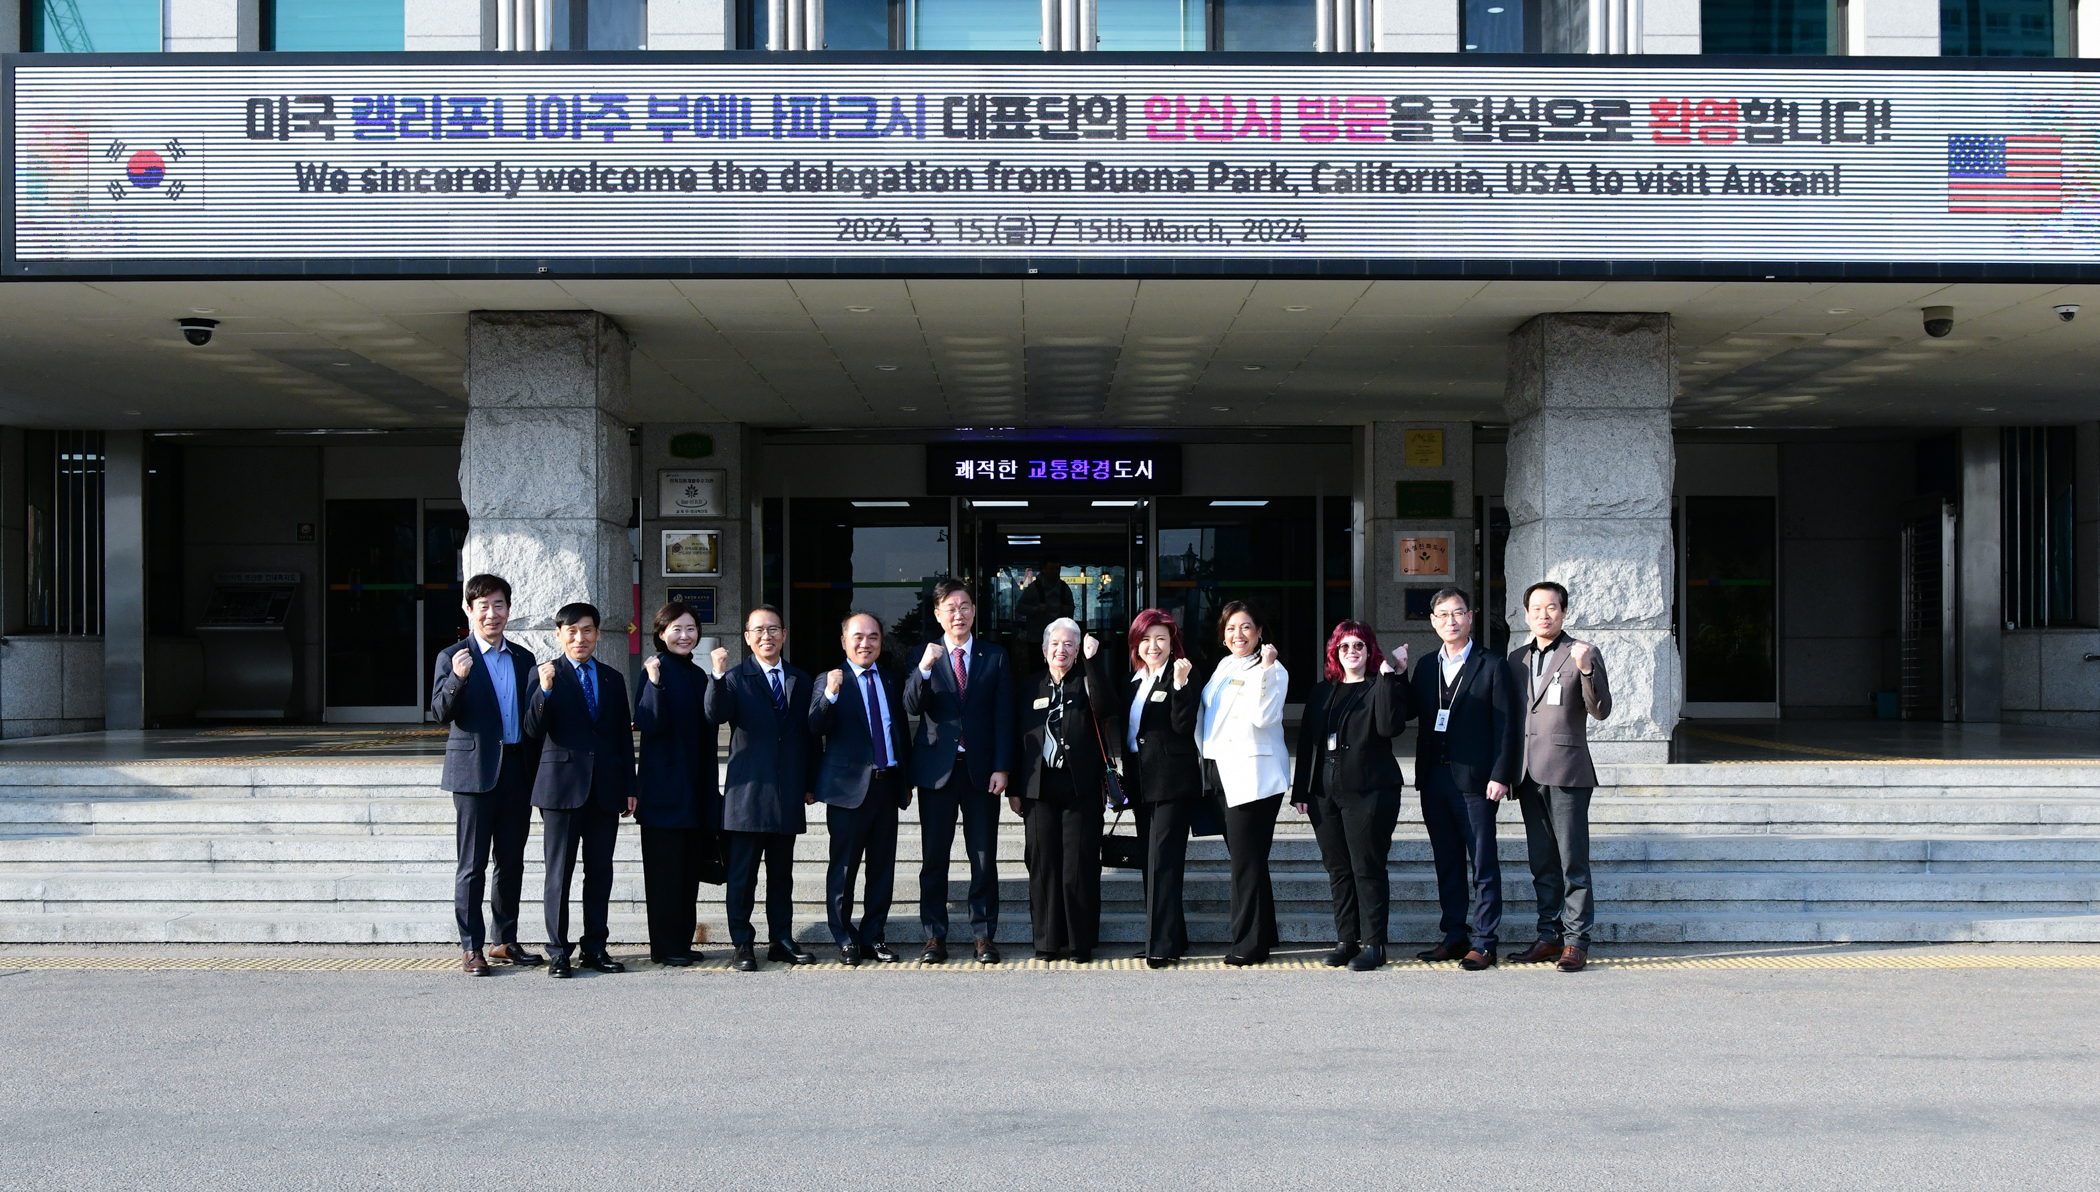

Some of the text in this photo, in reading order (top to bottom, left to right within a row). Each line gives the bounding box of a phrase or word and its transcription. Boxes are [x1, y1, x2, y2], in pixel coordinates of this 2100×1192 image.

[246, 94, 1891, 144] 미국 캘리포니아주 부에나파크시 대표단의 안산시 방문을 진심으로 환영합니다!
[296, 161, 1841, 199] We sincerely welcome the delegation from Buena Park, California, USA to visit Ansan!
[1048, 216, 1062, 245] /
[1074, 218, 1133, 243] 15th
[1143, 218, 1232, 247] March,
[1242, 218, 1308, 243] 2024
[955, 460, 1153, 480] 쾌적한 교통환경도시
[1404, 543, 1445, 554] 여성친화도시
